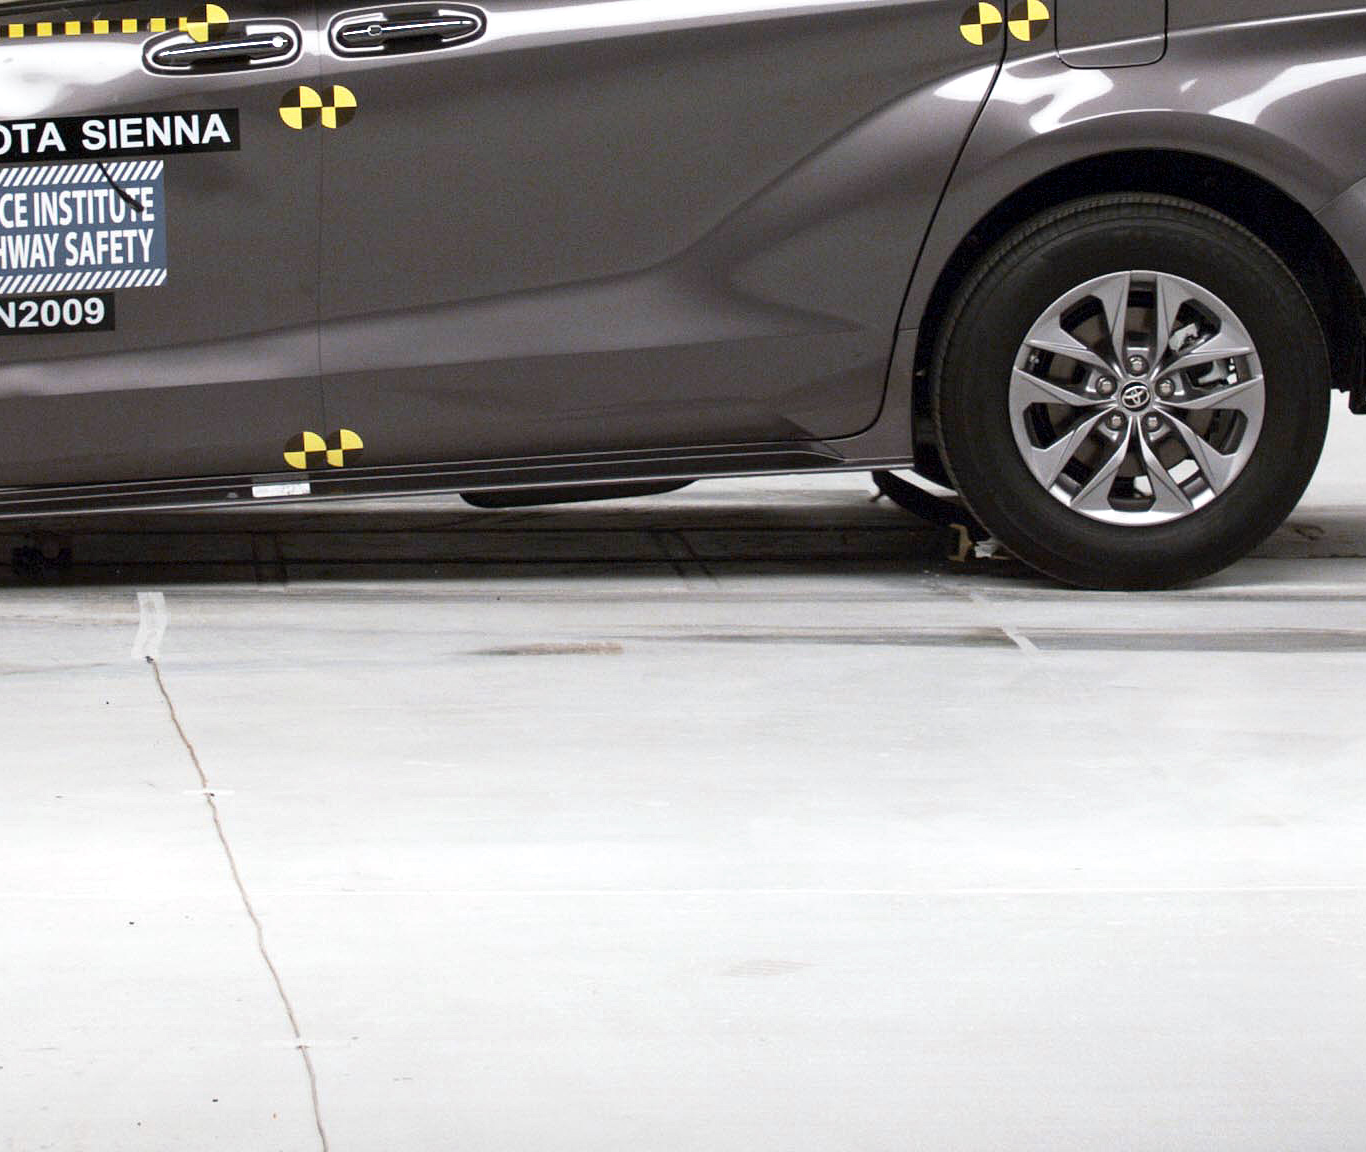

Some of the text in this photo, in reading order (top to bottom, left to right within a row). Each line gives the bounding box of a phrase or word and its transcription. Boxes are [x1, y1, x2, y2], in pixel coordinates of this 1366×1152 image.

[81, 112, 232, 150] SIENNA
[33, 186, 155, 228] INSTITUTE
[65, 228, 154, 266] SAFETY
